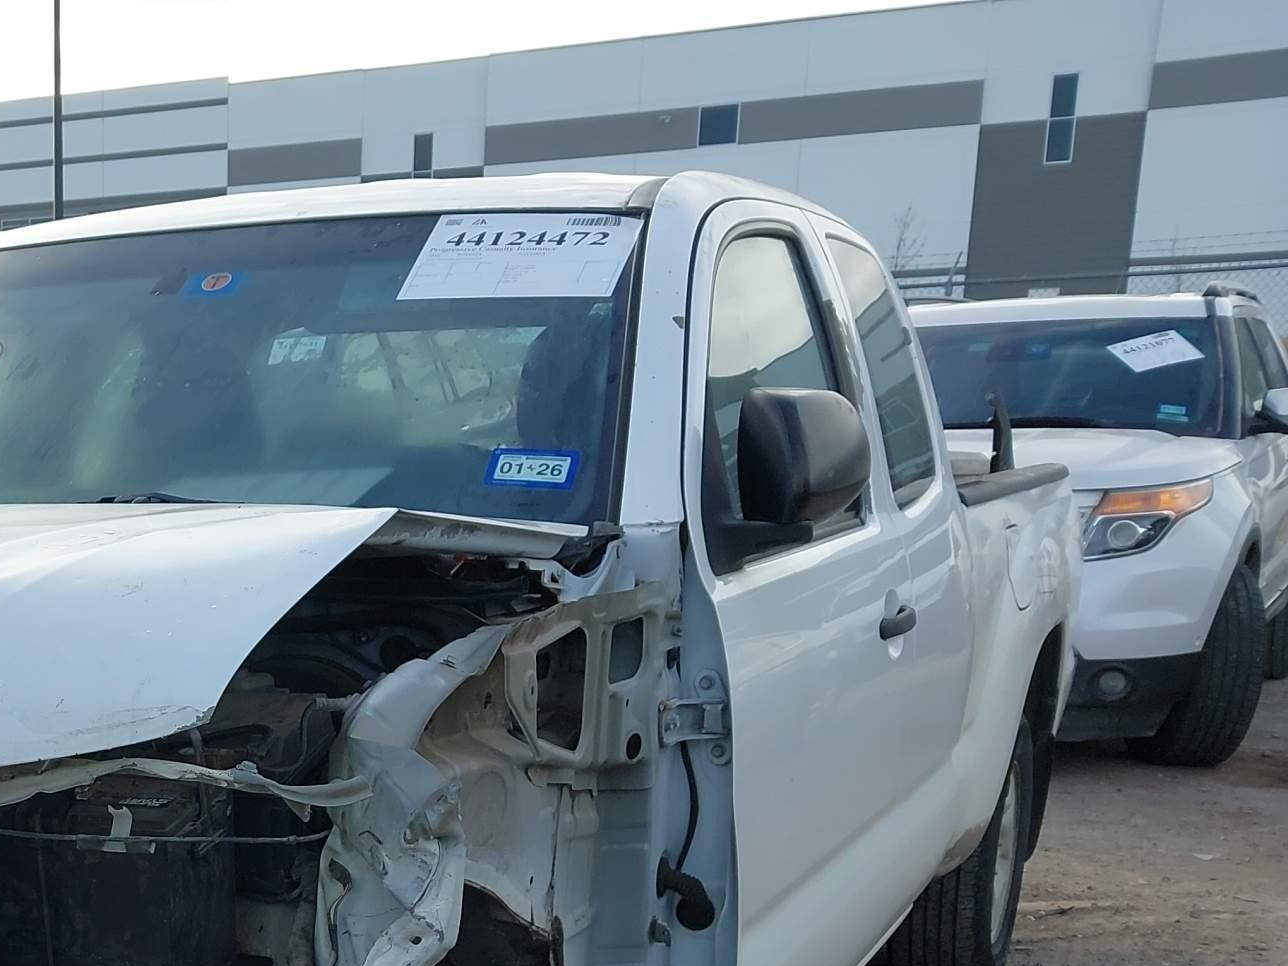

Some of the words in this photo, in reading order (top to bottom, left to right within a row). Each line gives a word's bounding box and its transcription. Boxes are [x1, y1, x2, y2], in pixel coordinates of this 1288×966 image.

[446, 231, 611, 247] 44124472
[499, 461, 524, 475] 01
[535, 463, 564, 477] 26
